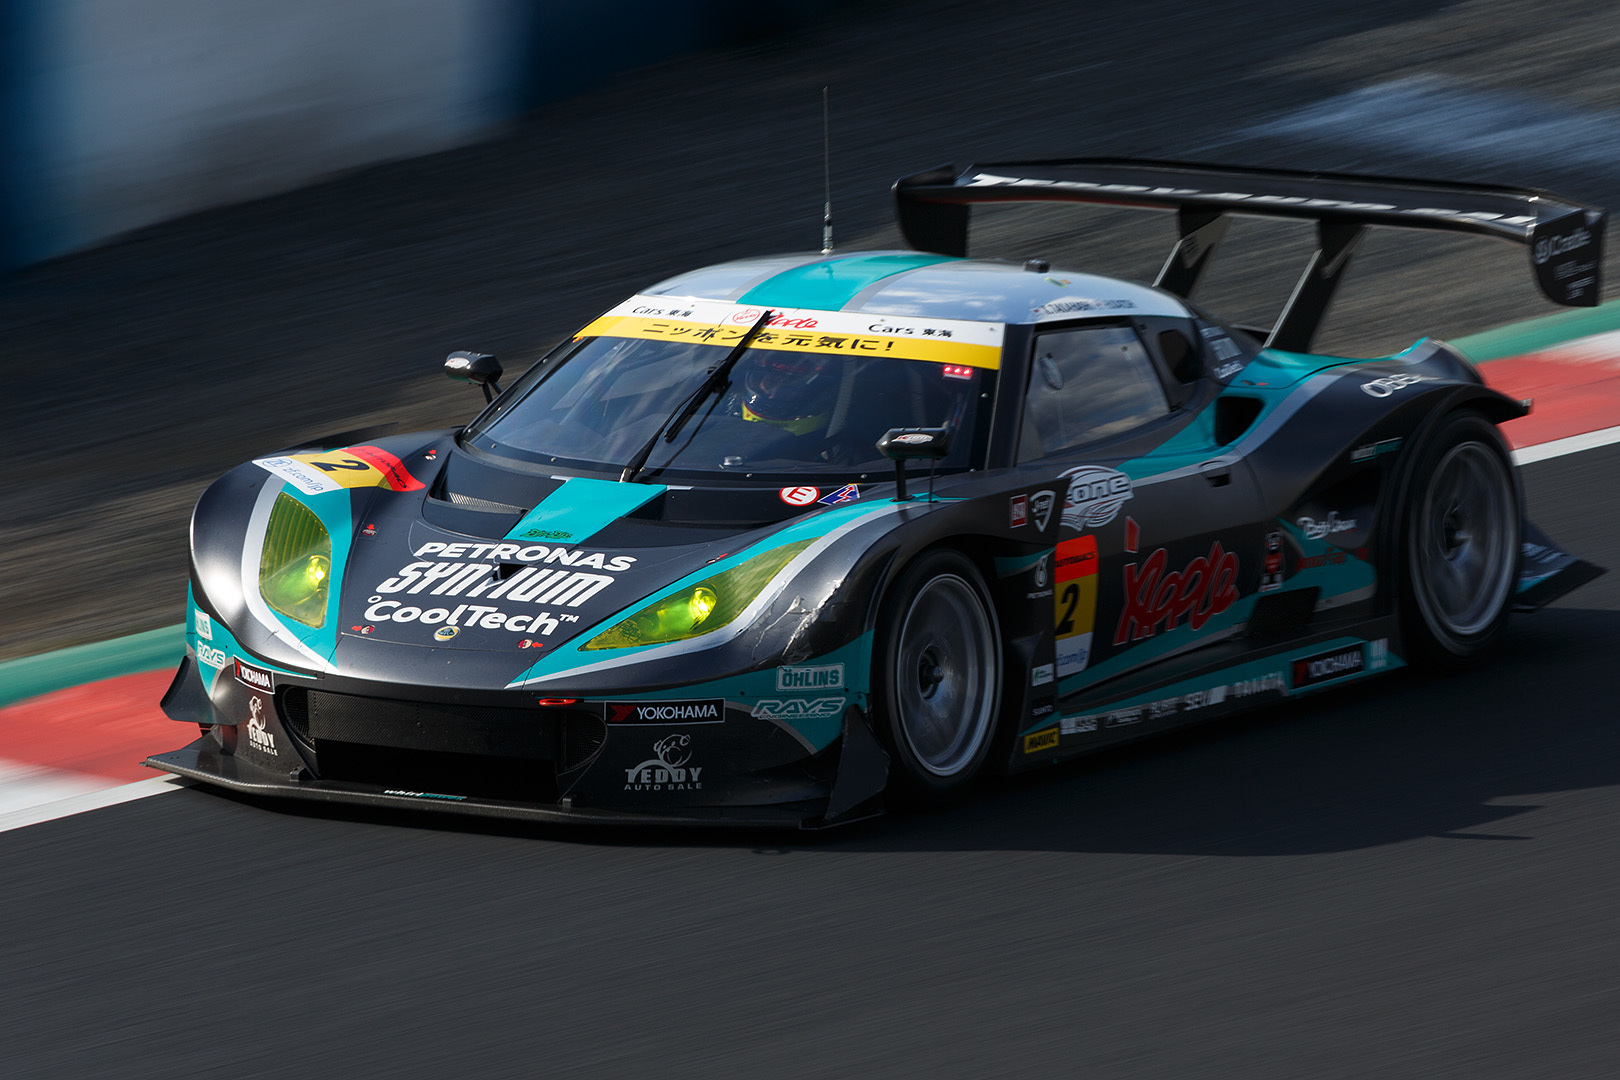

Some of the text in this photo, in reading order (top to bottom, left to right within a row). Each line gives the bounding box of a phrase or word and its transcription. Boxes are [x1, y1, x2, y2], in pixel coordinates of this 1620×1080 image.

[632, 305, 665, 316] Cars
[868, 323, 953, 338] Cars 東海
[310, 459, 370, 472] 2
[413, 542, 637, 572] PETRONAS
[1056, 583, 1079, 636] 2
[782, 667, 840, 688] ÖHLINS
[636, 704, 718, 720] YOKOHAMA
[752, 697, 846, 716] RAYS
[625, 763, 702, 784] TEDDY
[624, 783, 703, 791] AUTO SALE
